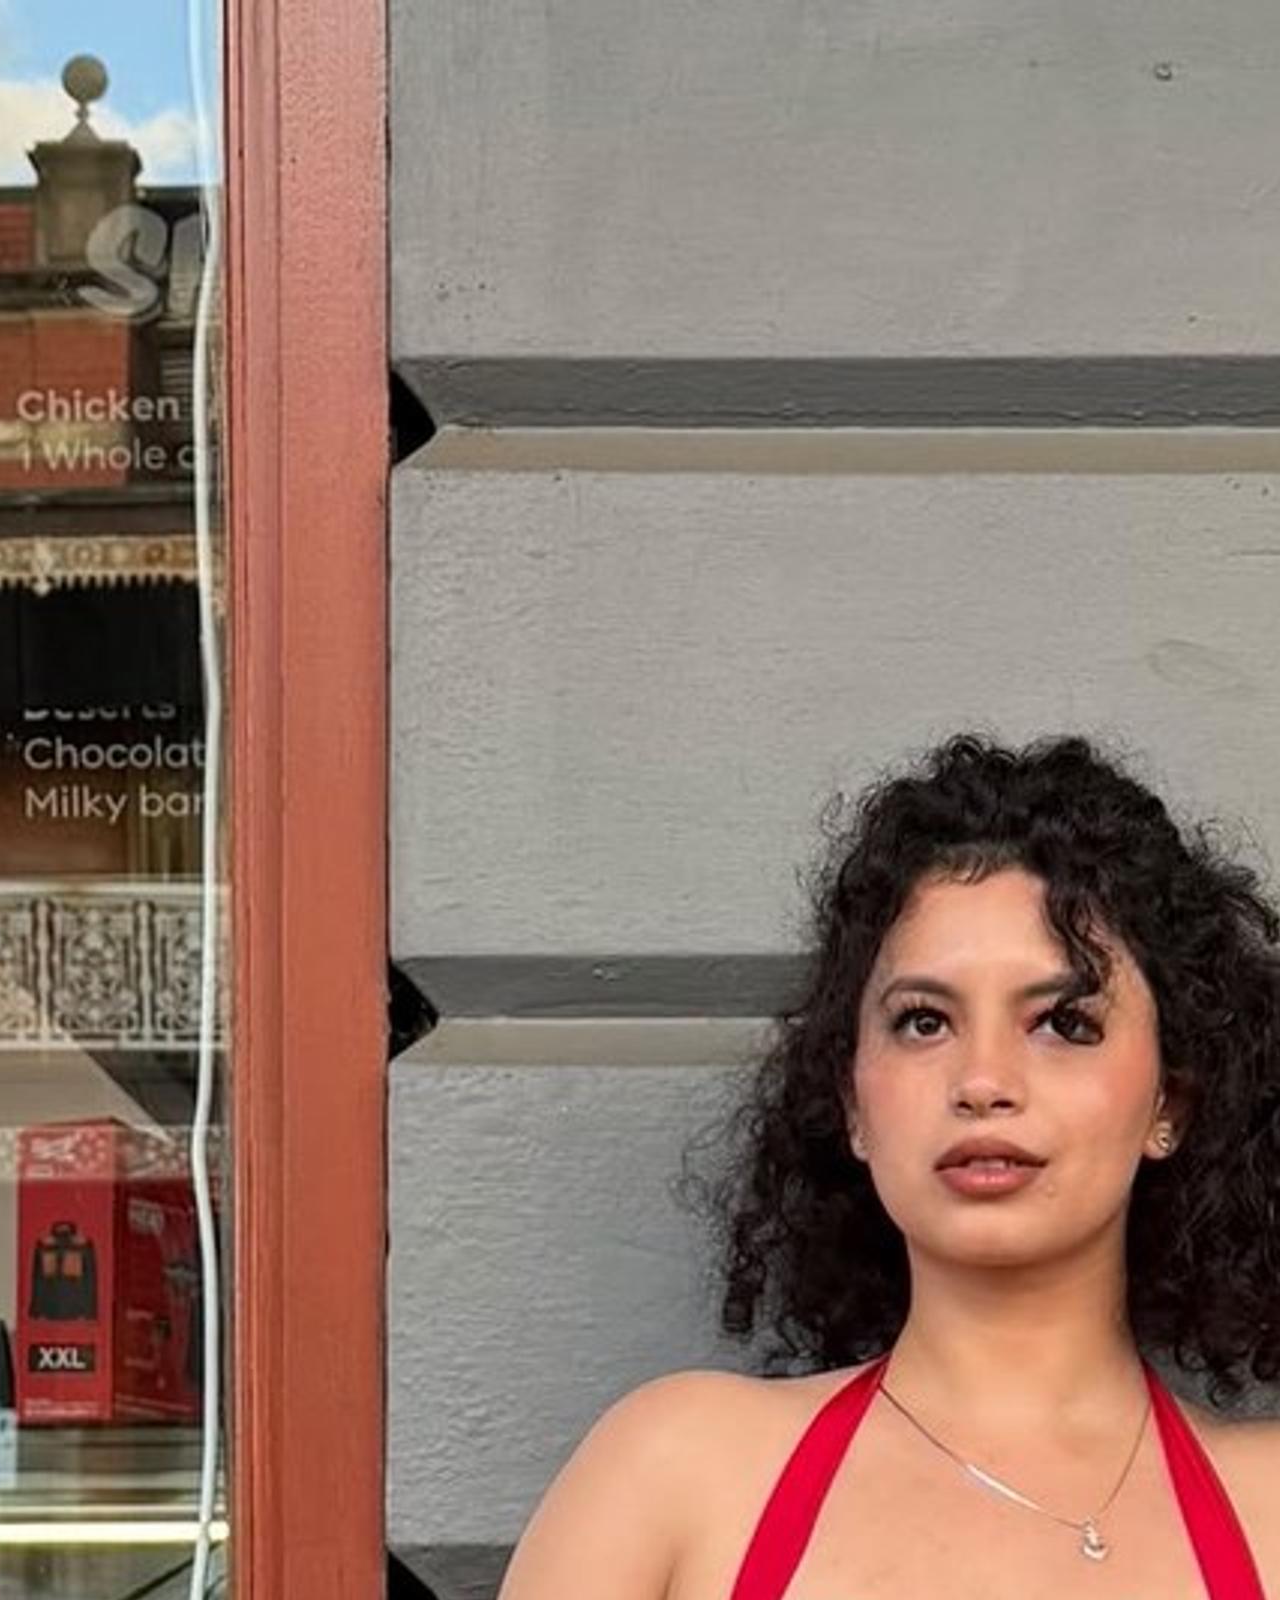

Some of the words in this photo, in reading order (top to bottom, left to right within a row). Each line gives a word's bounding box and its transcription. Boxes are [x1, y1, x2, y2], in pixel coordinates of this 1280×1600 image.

[17, 389, 181, 421] Chicken
[42, 437, 167, 470] Whole
[24, 734, 207, 769] Chocolat
[24, 784, 128, 825] Milky
[39, 1346, 86, 1369] XXL
